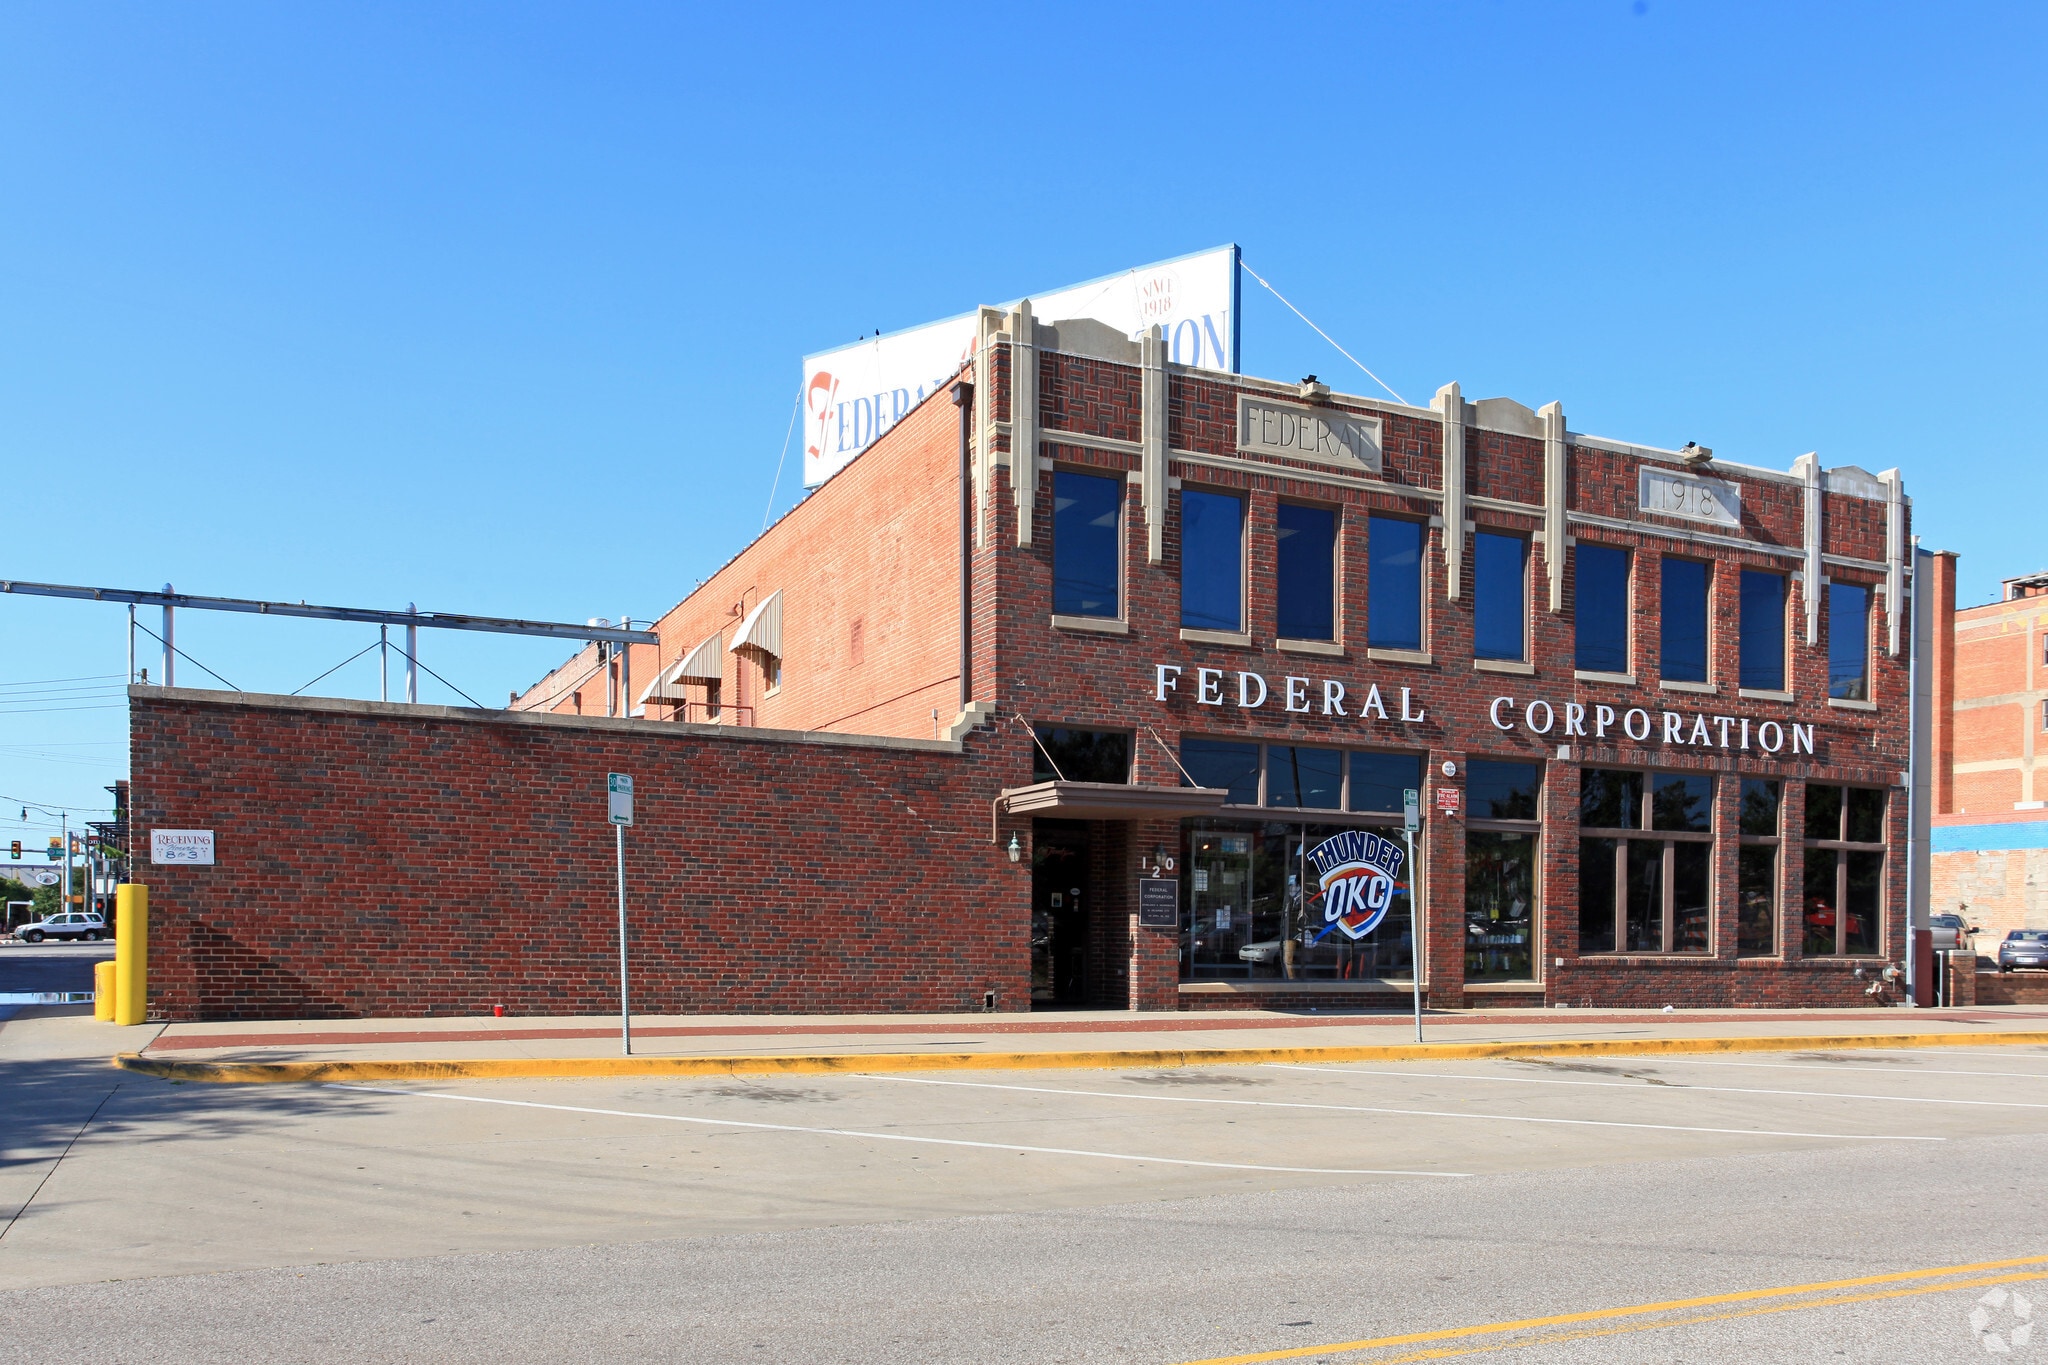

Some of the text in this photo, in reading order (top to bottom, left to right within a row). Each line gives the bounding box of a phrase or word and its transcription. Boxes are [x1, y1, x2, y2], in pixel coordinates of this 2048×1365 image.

[1144, 297, 1171, 316] 1918
[808, 371, 943, 459] FEDER
[1248, 407, 1374, 461] FEDERAL
[1662, 478, 1714, 515] 1918
[1155, 664, 1814, 755] FEDERAL CORPORATION
[156, 834, 211, 846] RECEIVING
[166, 851, 176, 859] 8
[187, 851, 198, 859] 3
[1306, 830, 1405, 879] THUNDER
[1324, 875, 1388, 922] OKC
